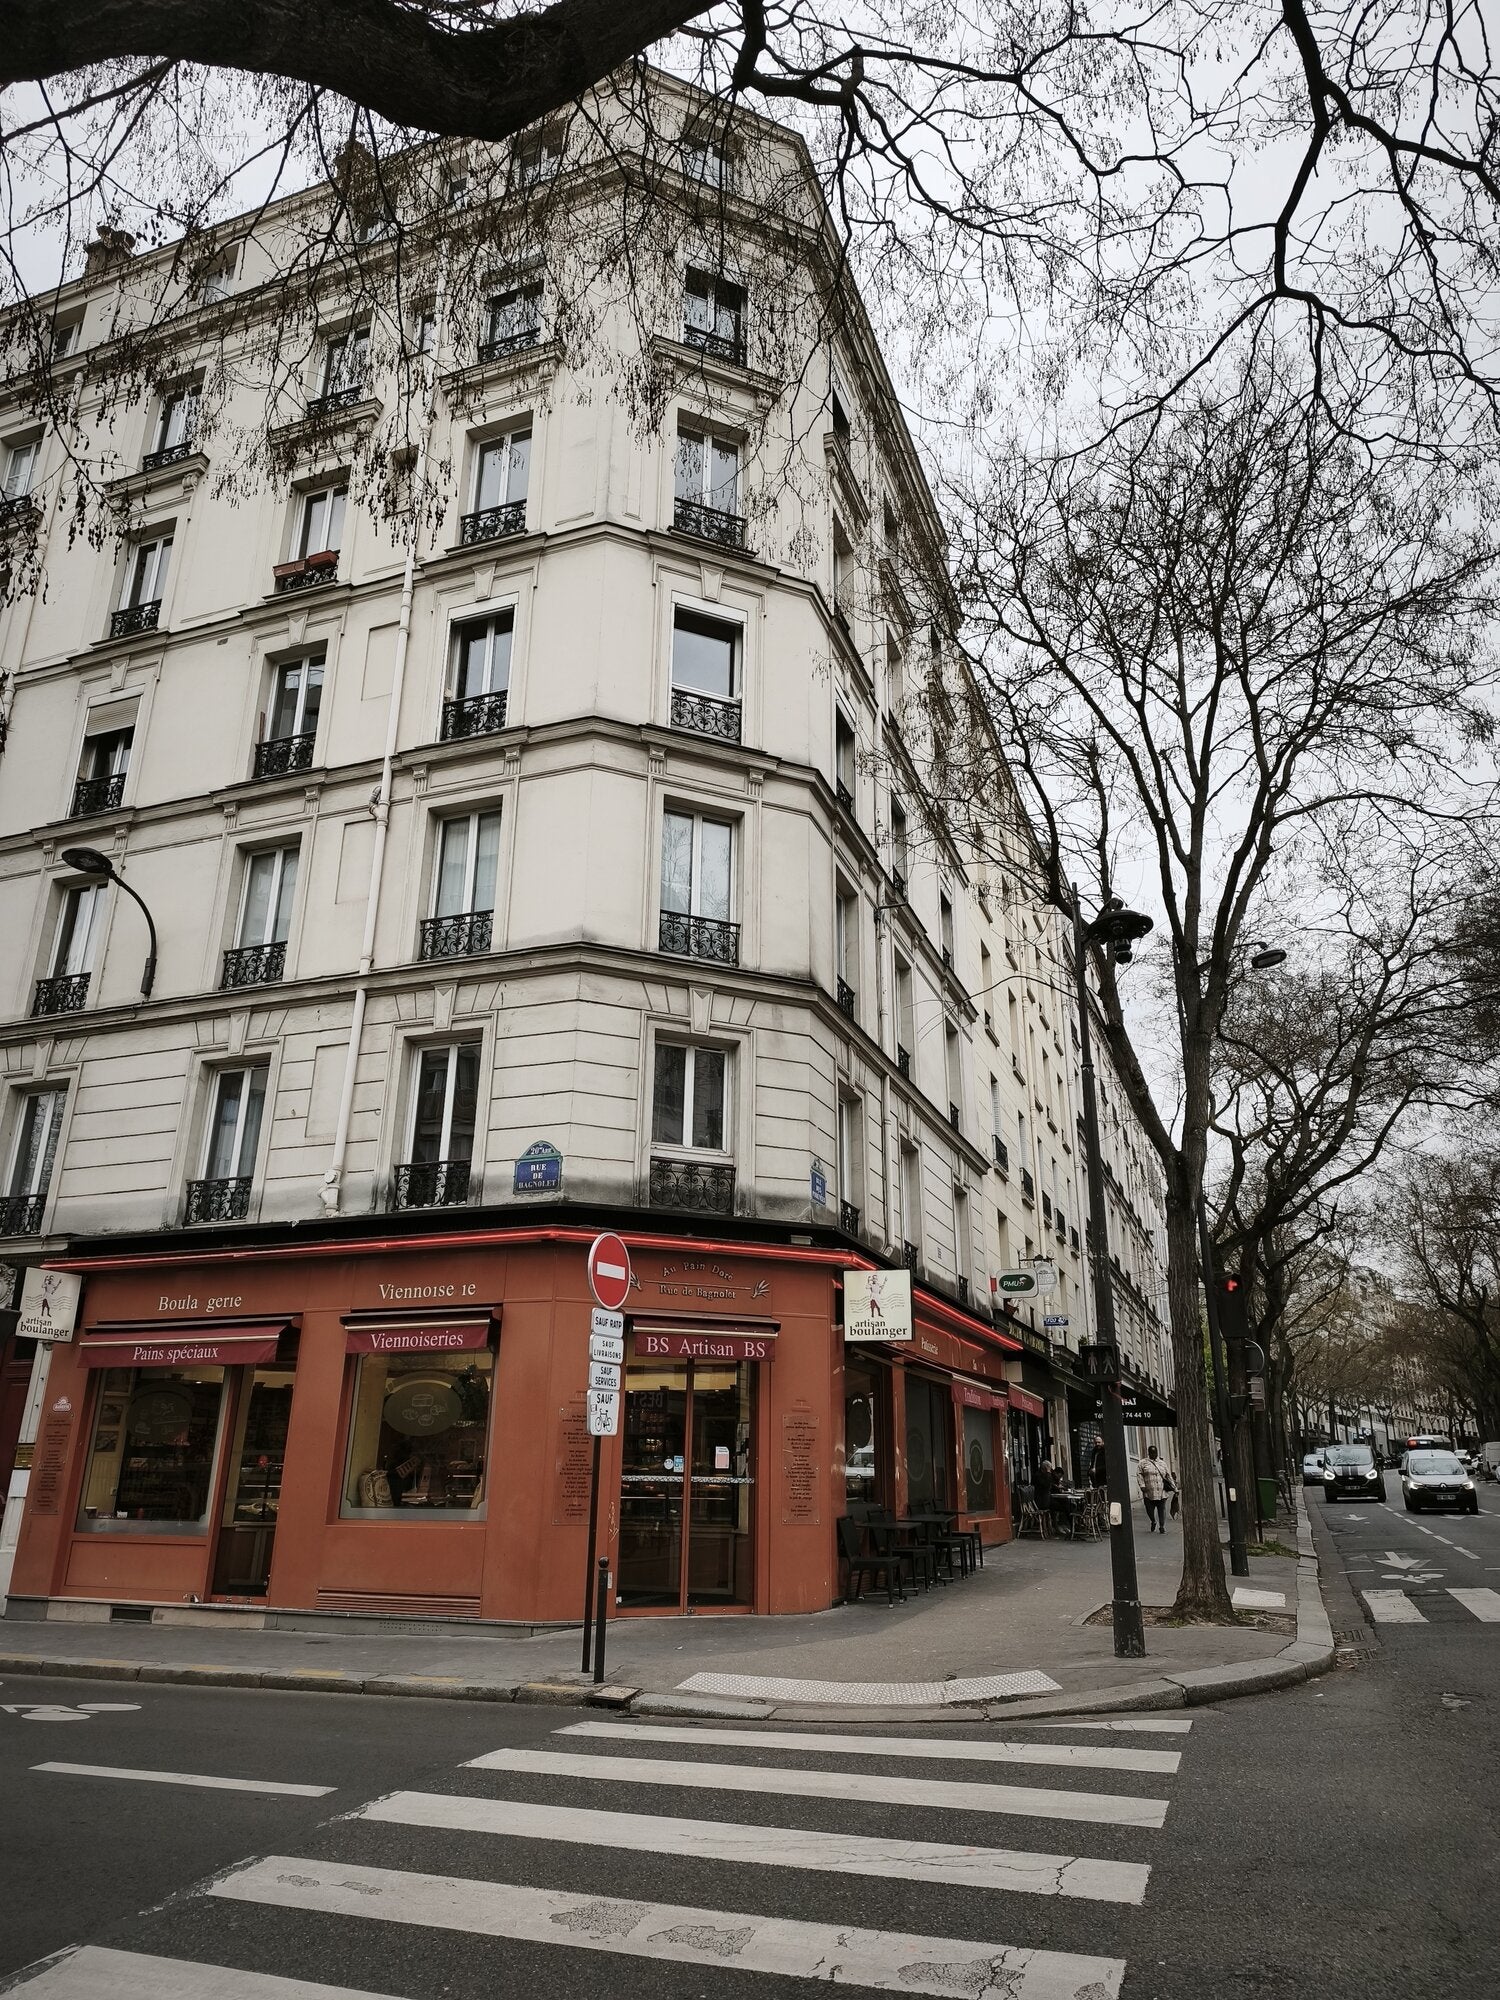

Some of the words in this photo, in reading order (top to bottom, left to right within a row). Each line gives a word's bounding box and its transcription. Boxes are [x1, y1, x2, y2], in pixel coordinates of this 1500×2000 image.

[530, 1163, 547, 1172] RUE
[532, 1172, 543, 1180] DE
[518, 1180, 556, 1189] BAGNOLET
[663, 1266, 677, 1277] Au
[683, 1261, 706, 1271] Pain
[660, 1284, 679, 1295] Rue
[682, 1286, 693, 1296] de
[697, 1287, 736, 1301] Bagnolet
[158, 1295, 198, 1311] Boula
[26, 1317, 52, 1327] artisan
[595, 1316, 609, 1327] SAUF
[610, 1319, 622, 1329] RATP
[855, 1319, 886, 1328] artisan
[20, 1321, 70, 1339] boulanger
[850, 1326, 907, 1338] boulanger
[371, 1330, 463, 1349] Viennoiseries
[602, 1340, 614, 1348] SAUF
[646, 1336, 669, 1353] BS
[679, 1338, 734, 1356] Artisan
[744, 1341, 766, 1358] BS
[133, 1346, 164, 1360] Pains
[167, 1345, 218, 1363] spéciaux
[594, 1348, 621, 1359] LIVRAISONS
[600, 1366, 612, 1375] SAUF
[595, 1376, 617, 1387] SERVICES
[596, 1393, 613, 1404] SAUF
